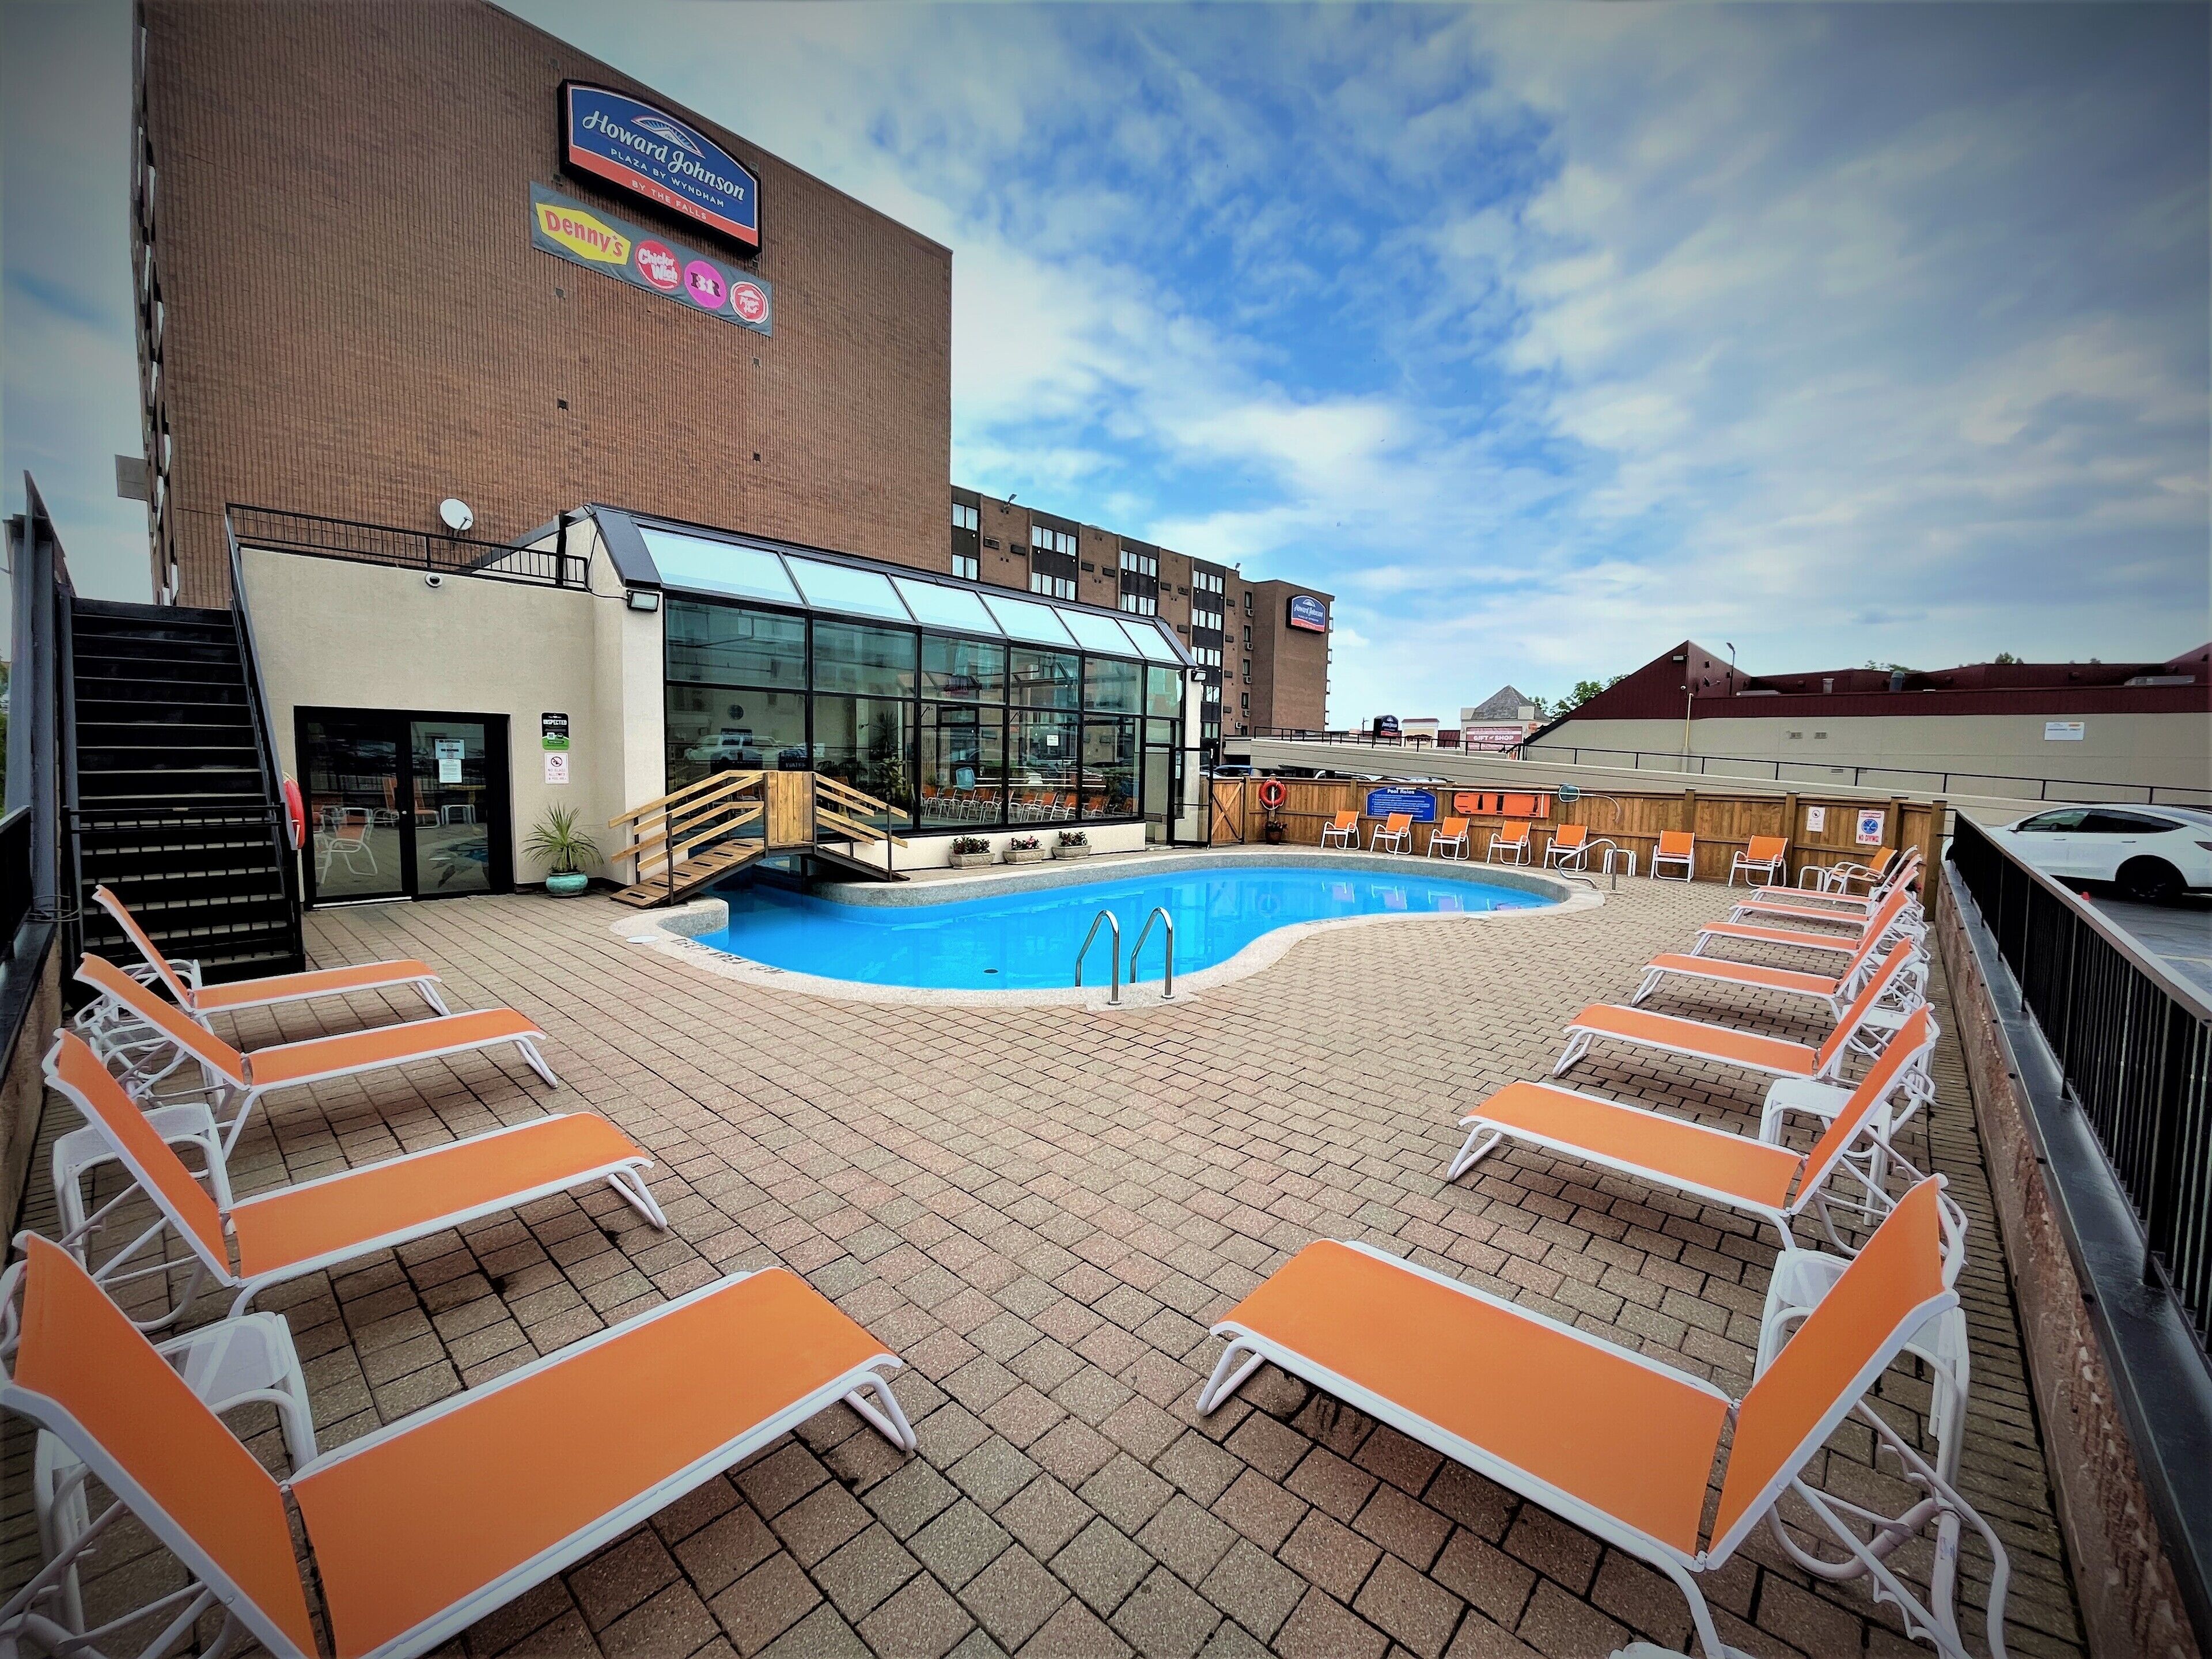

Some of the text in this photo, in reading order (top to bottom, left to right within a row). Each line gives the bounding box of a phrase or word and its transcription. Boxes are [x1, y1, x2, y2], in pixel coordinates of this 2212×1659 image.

[582, 110, 745, 201] Howard Johnson
[611, 148, 724, 209] PLAZA BY WYNDHAM
[631, 179, 707, 220] BY THE FALLS
[544, 209, 623, 257] Denny's
